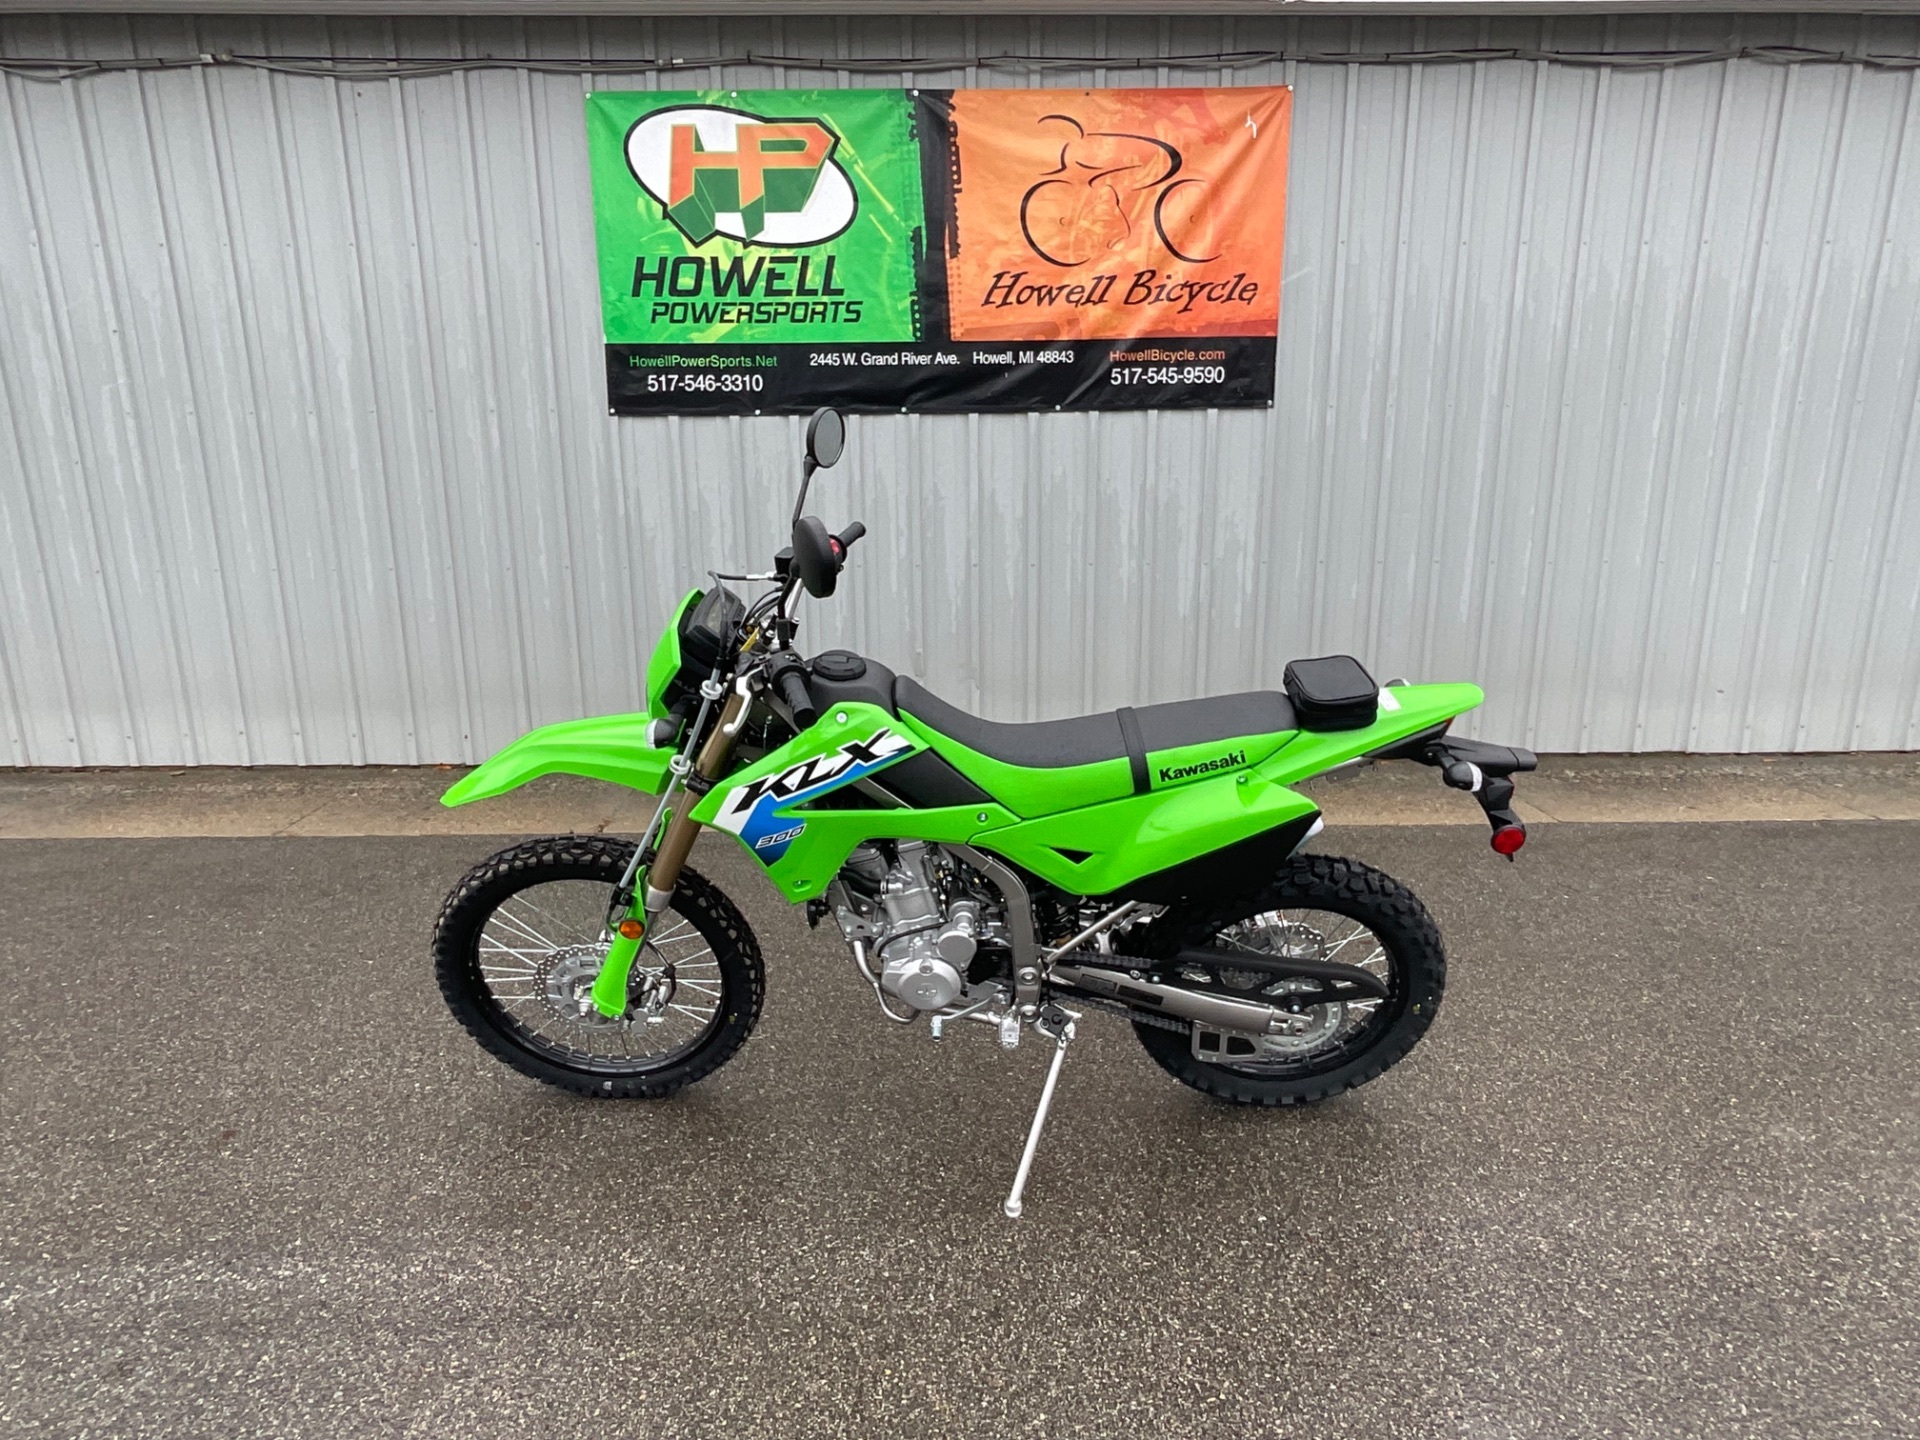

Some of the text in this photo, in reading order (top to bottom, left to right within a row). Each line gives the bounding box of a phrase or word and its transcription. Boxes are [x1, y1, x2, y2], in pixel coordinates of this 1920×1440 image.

[631, 255, 845, 298] HOWELL
[981, 269, 1259, 314] Howell Bicycle
[651, 301, 863, 324] POWERSPORTS
[629, 355, 778, 370] HowellPowerSports.Net
[810, 352, 960, 366] 2445 W. Grand River Ave.
[973, 351, 1074, 366] Howell, MI 48843
[1109, 349, 1226, 364] HowellBicycle.com
[647, 374, 764, 393] 517-546-3310
[1110, 367, 1225, 385] 517-545-9590
[731, 727, 916, 814] KLX
[1159, 750, 1246, 782] Kawasaki
[755, 823, 807, 849] 300
